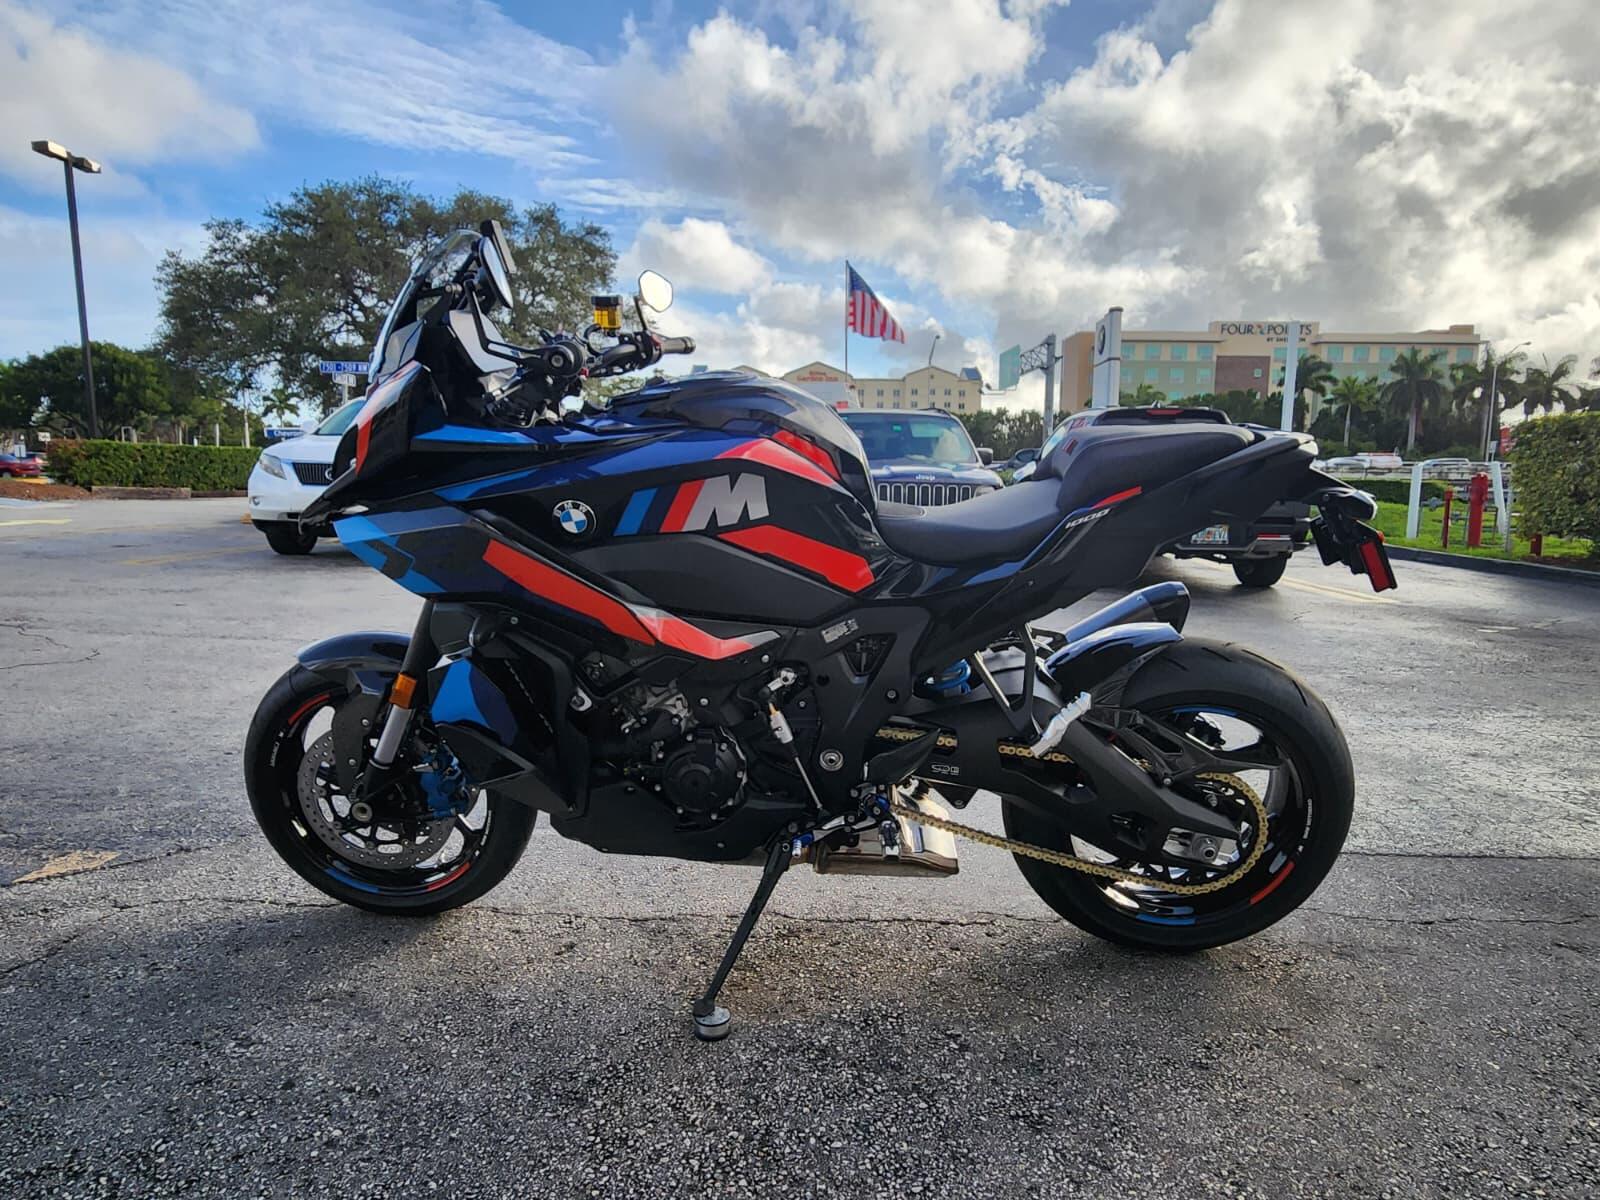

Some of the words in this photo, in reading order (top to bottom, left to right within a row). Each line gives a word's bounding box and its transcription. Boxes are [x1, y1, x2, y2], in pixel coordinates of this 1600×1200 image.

[1221, 324, 1254, 335] FOUR
[1267, 324, 1312, 335] POITS
[553, 502, 588, 517] BMW
